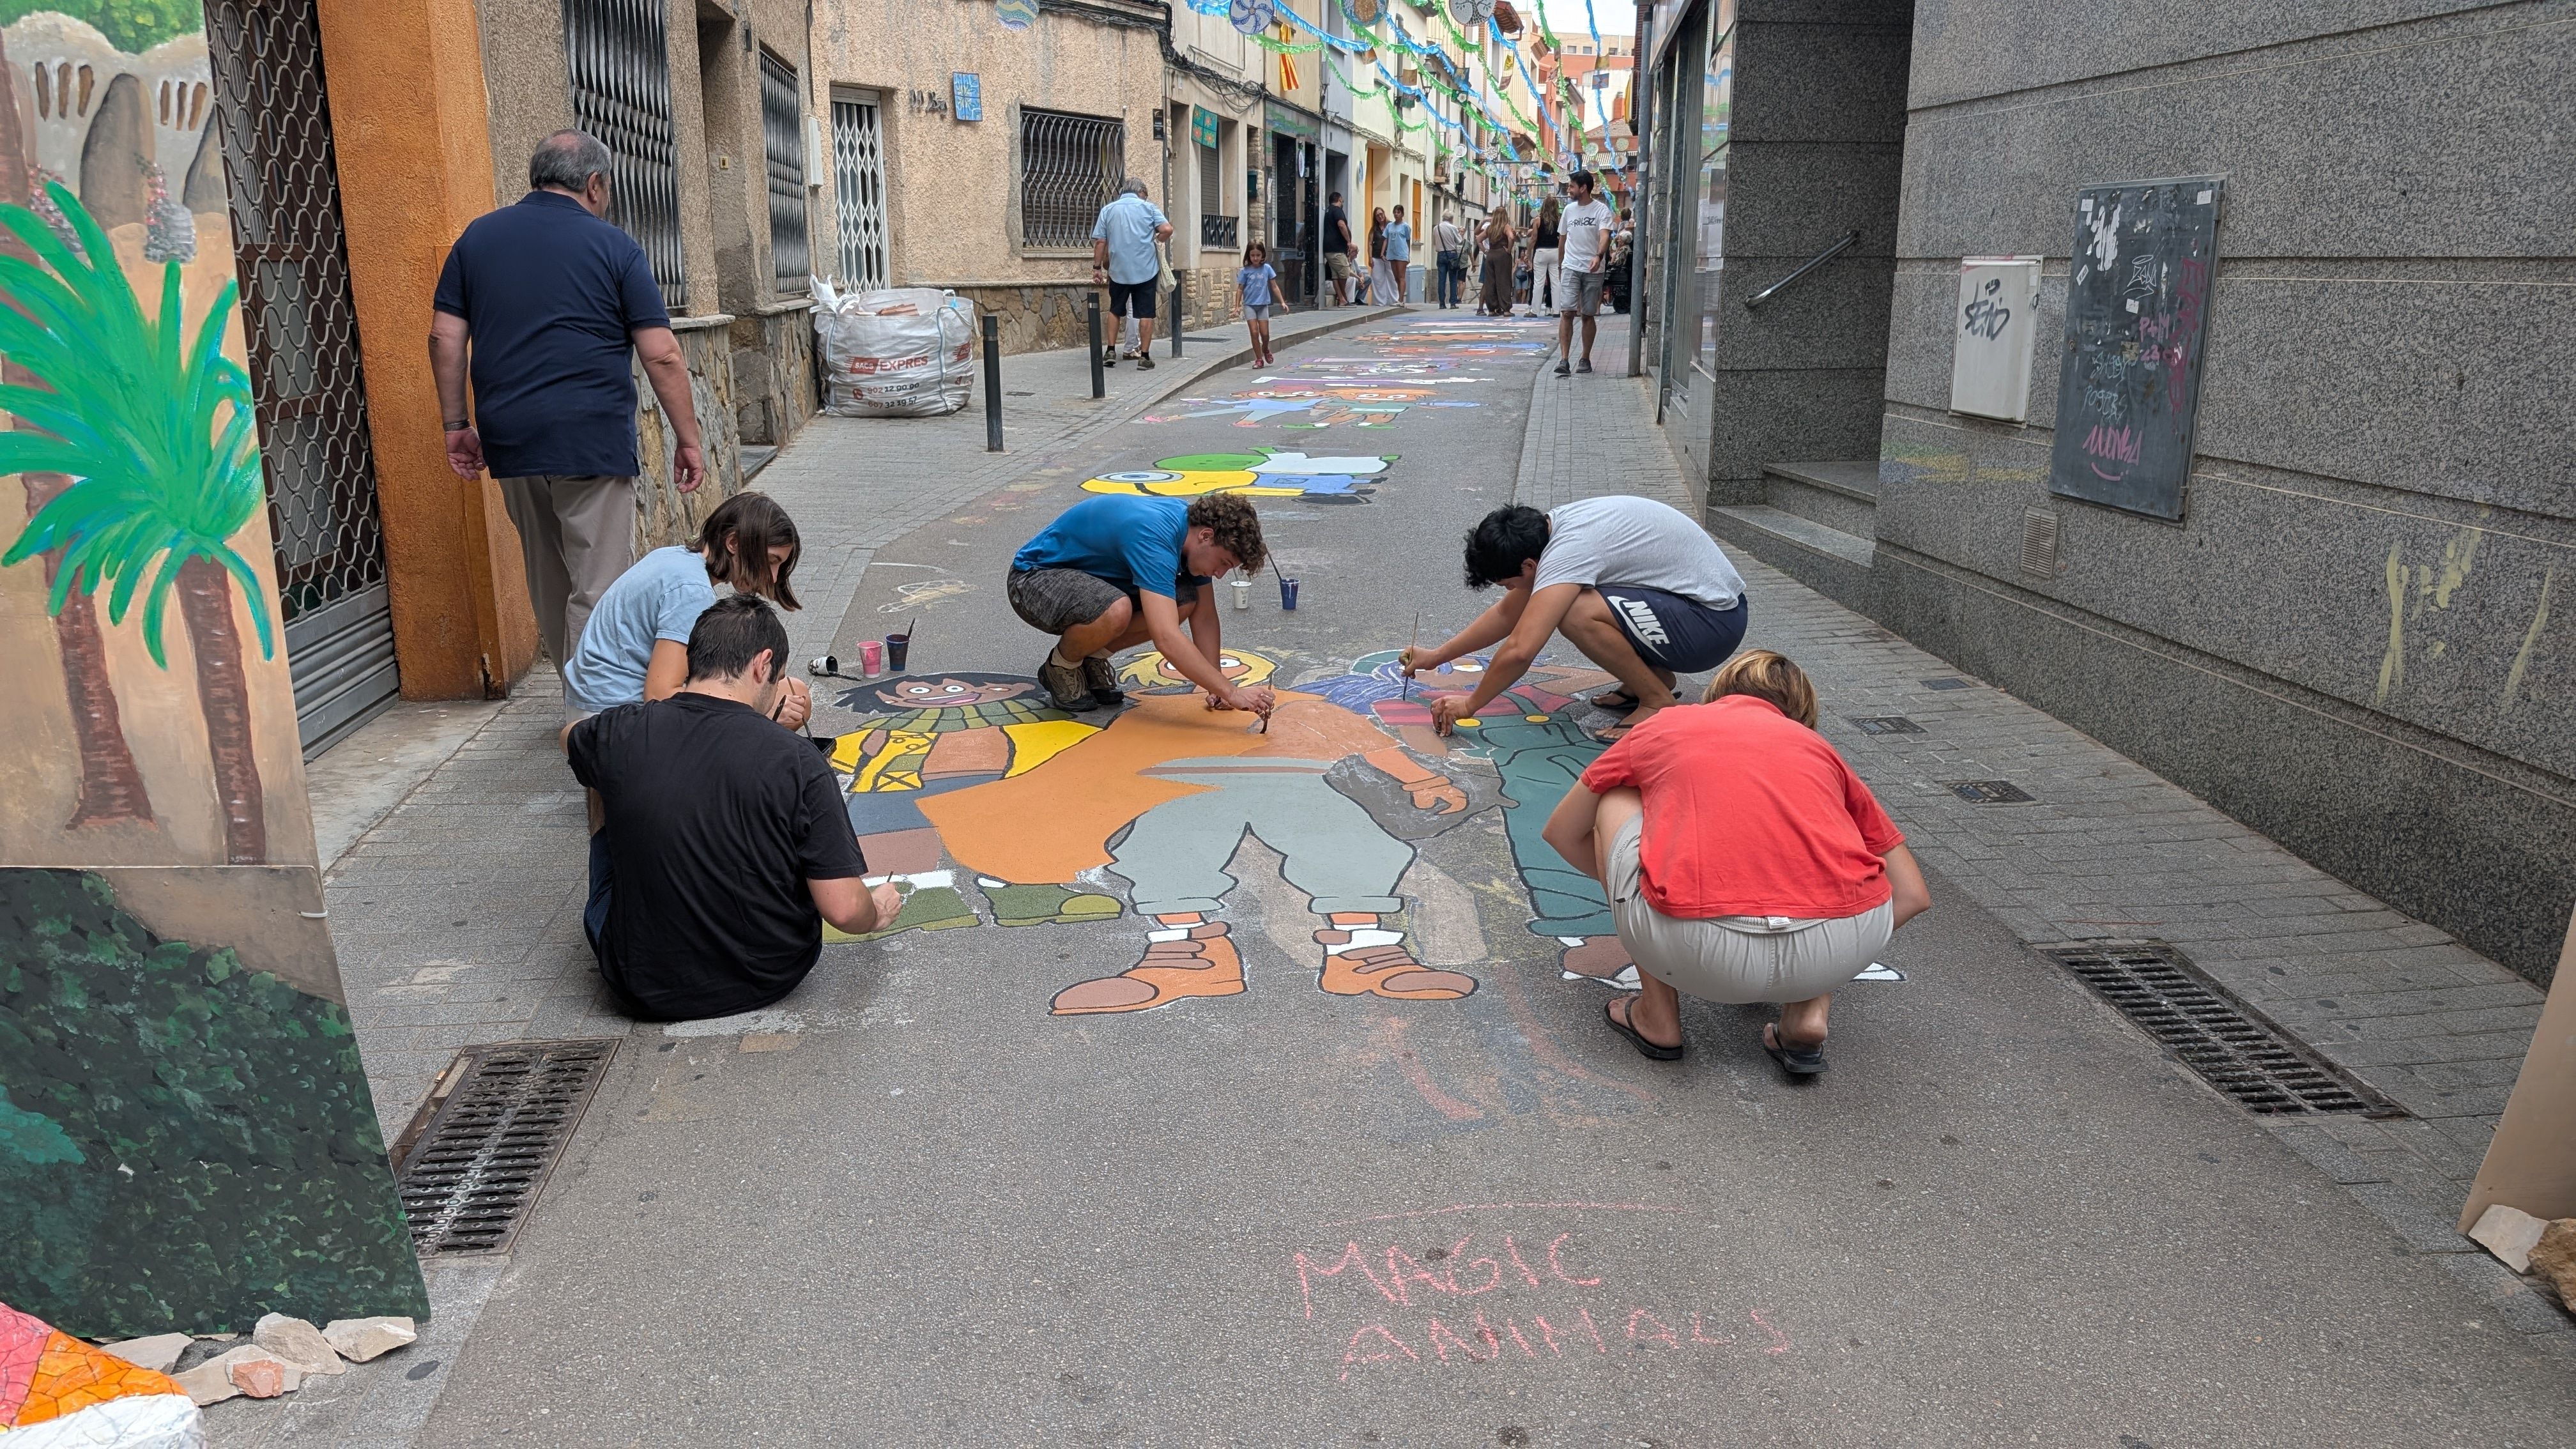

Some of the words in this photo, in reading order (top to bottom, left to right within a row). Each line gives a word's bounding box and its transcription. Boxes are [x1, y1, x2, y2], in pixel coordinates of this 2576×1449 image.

[880, 356, 928, 371] EXPRES
[908, 396, 917, 405] 57
[1623, 601, 1670, 644] NIKE
[1294, 1232, 1601, 1320] MAGIC
[1339, 1308, 1790, 1381] ANIMALS
